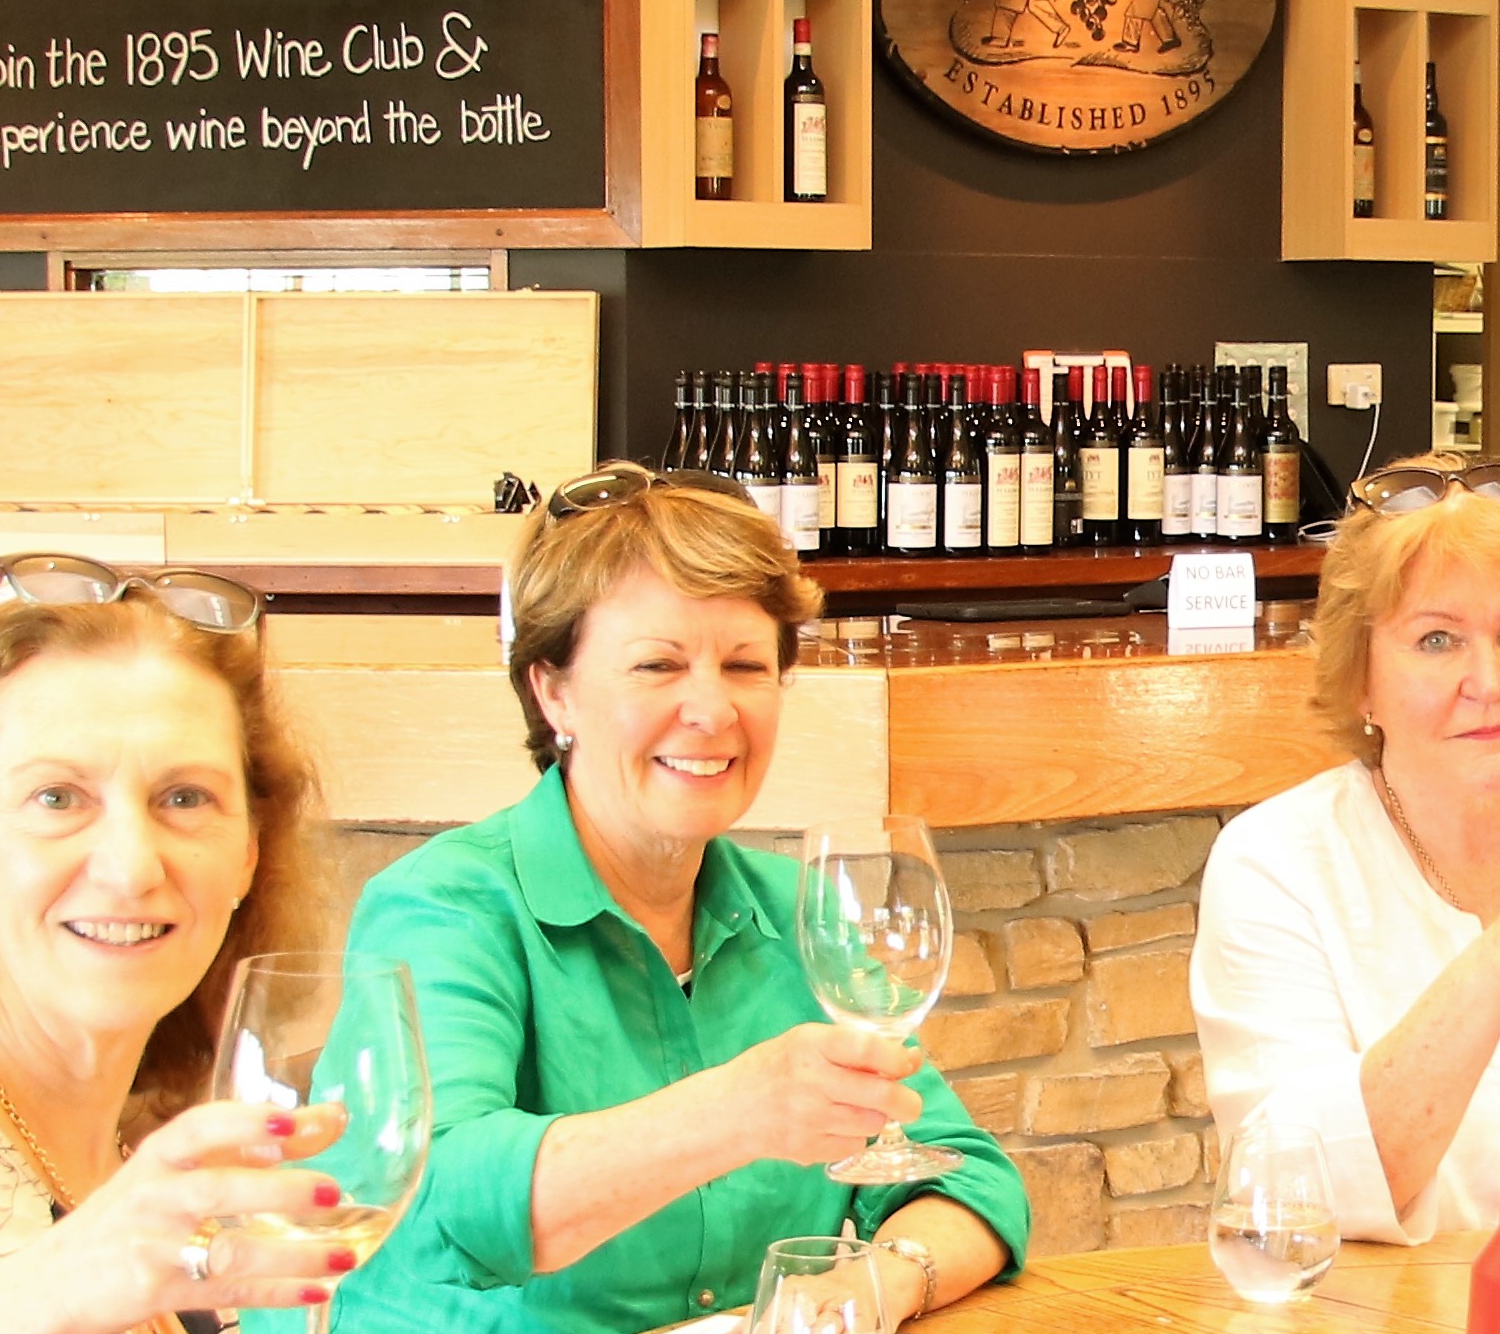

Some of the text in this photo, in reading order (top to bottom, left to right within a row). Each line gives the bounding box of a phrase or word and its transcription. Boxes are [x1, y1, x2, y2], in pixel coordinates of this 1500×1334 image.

[45, 36, 107, 88] the
[124, 29, 220, 87] 1895
[235, 26, 332, 79] Wine
[342, 23, 426, 73] Club
[434, 11, 488, 81] &
[165, 108, 247, 153] wine
[260, 99, 372, 171] beyond
[383, 99, 441, 147] the
[459, 93, 552, 147] bottle
[943, 58, 1217, 132] ESTABLISHED 1895
[1186, 565, 1246, 580] NO BAR
[1186, 595, 1247, 610] SERVICE
